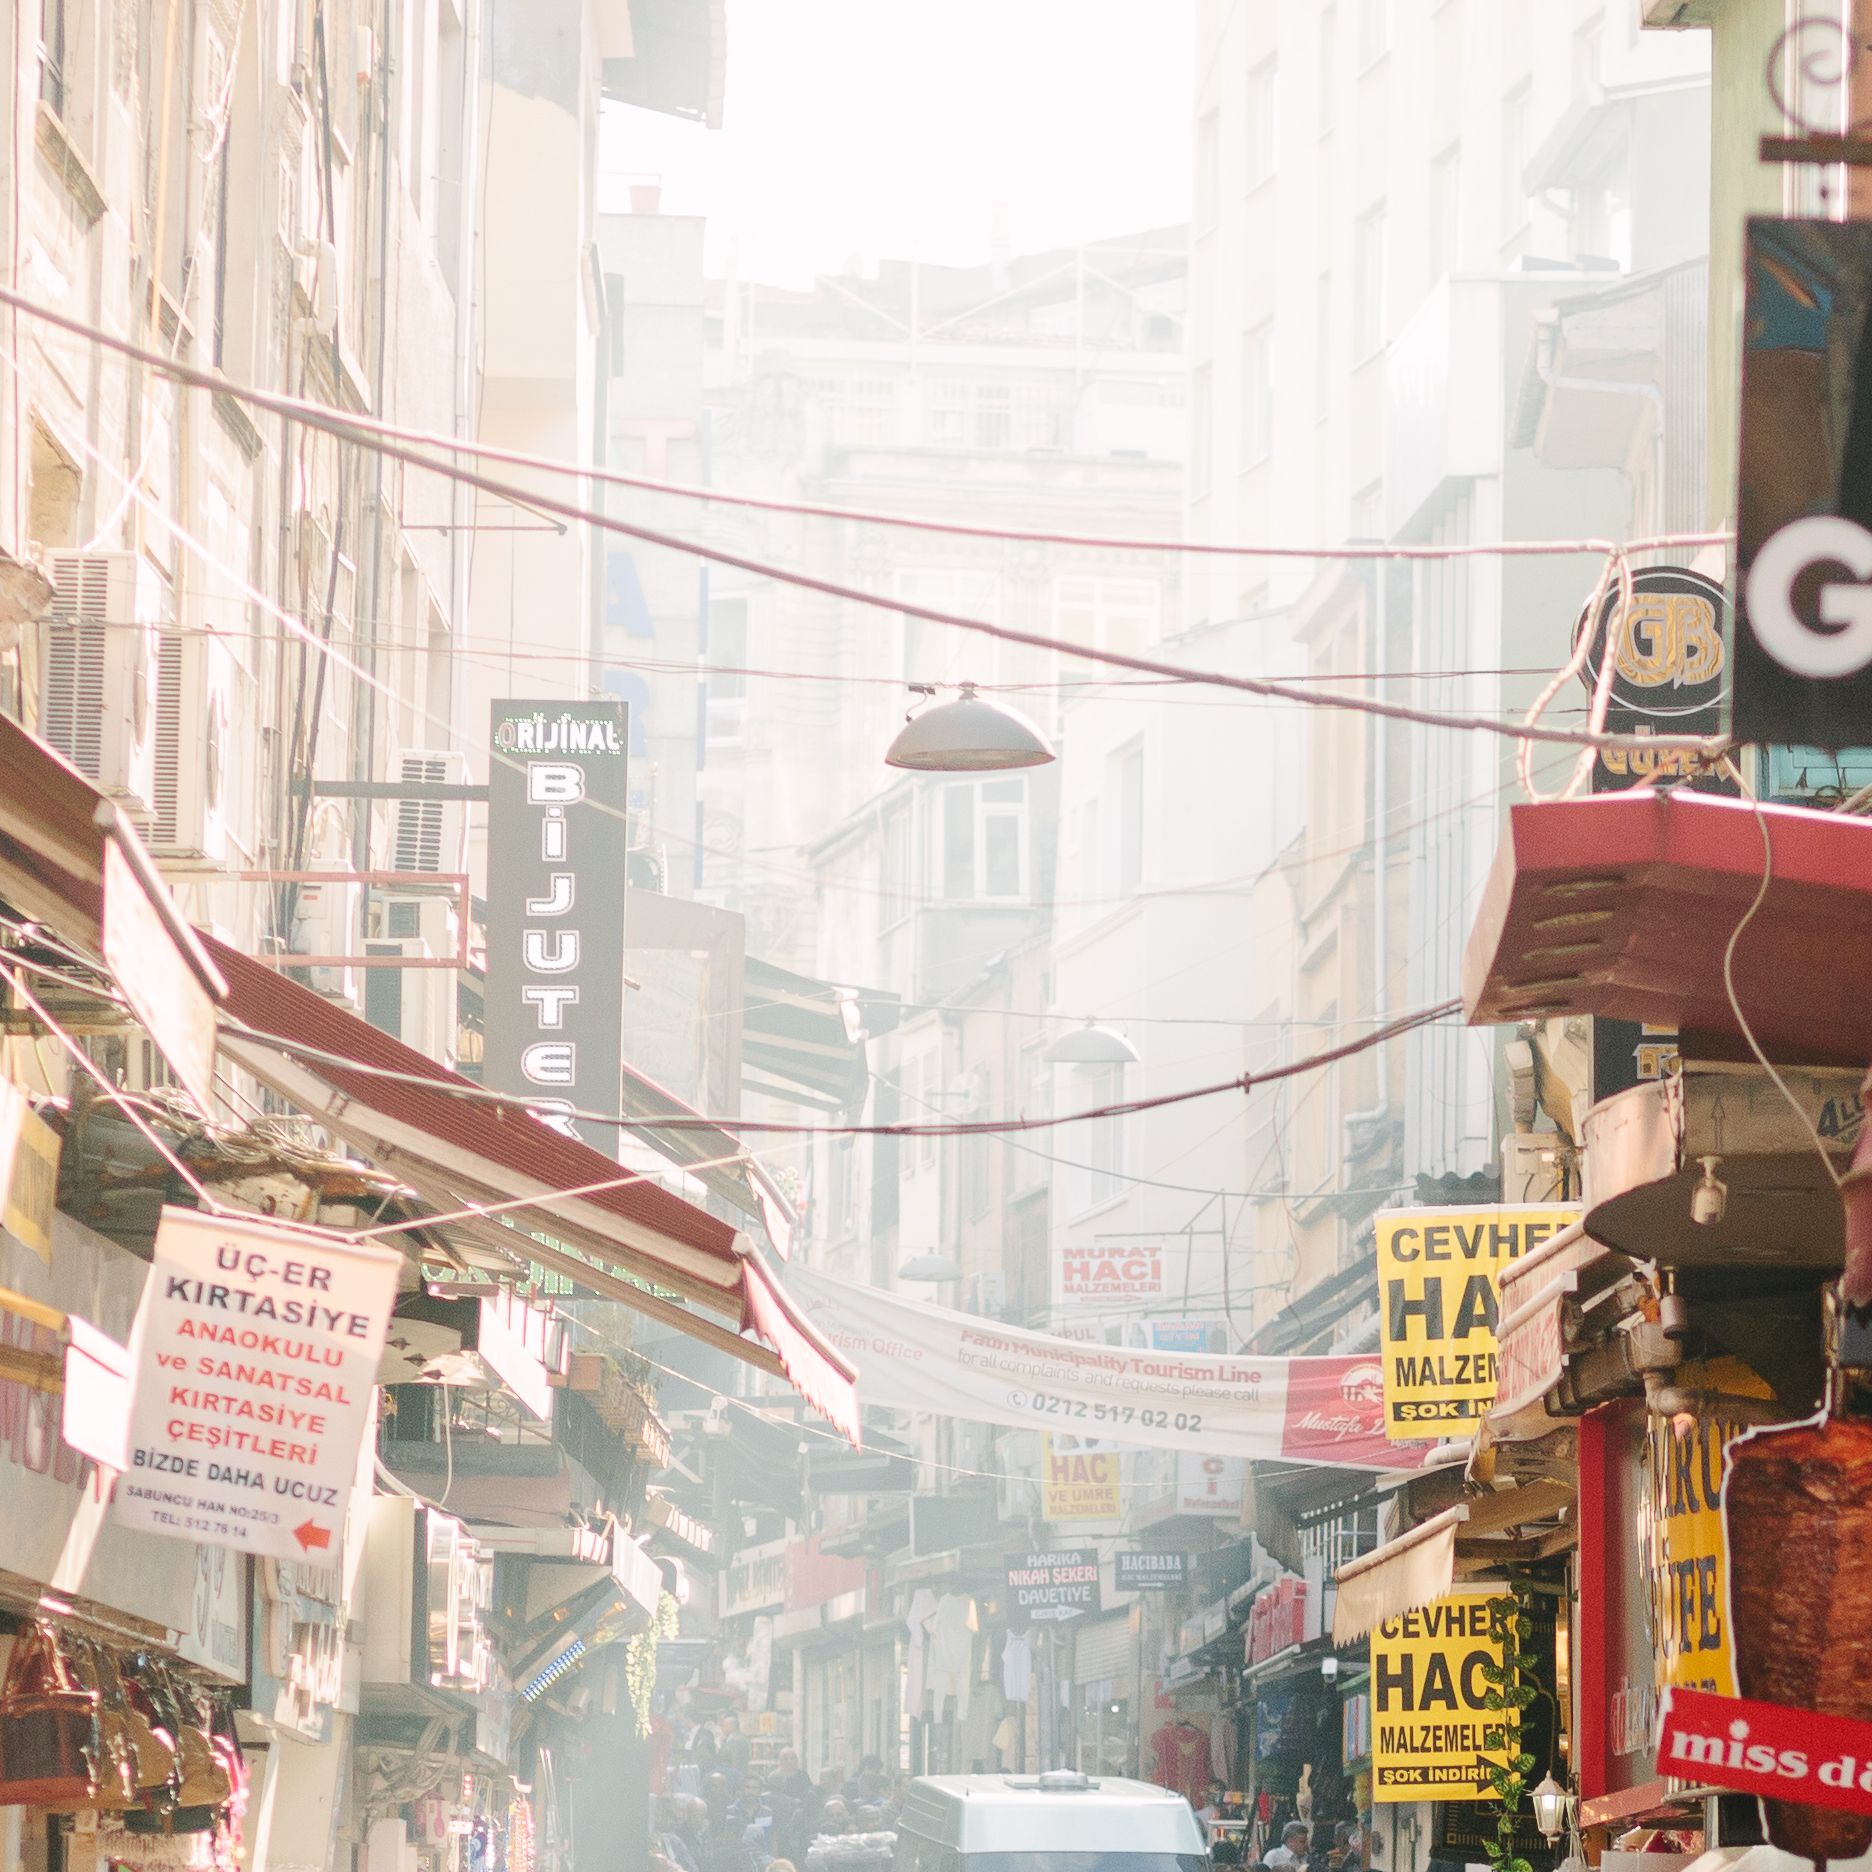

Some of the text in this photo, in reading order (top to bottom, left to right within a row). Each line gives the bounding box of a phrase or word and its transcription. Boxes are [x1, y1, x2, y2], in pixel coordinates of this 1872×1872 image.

[217, 1243, 332, 1291] ÜÇ-ER
[1063, 1259, 1161, 1281] HACI
[165, 1275, 370, 1339] KIRTASİYE
[1388, 1274, 1499, 1341] HA
[177, 1318, 344, 1368] ANAOKULU
[825, 1332, 924, 1361] rism Office
[155, 1352, 351, 1405] ve SANATSAL
[958, 1348, 1260, 1402] for all complaints and requests please call
[1130, 1358, 1215, 1382] Tourism
[1218, 1365, 1262, 1383] Line
[169, 1386, 326, 1435] KIRTASİYE
[1033, 1392, 1202, 1433] 0212 517 02 02
[1292, 1411, 1386, 1441] Mustafa D
[1400, 1399, 1495, 1421] ŞOK İN
[166, 1419, 319, 1466] ÇEŞİTLERİ
[133, 1447, 339, 1507] BİZDE DAHA UCUZ
[1050, 1453, 1108, 1485] HAC
[126, 1485, 192, 1508] SABUNCU
[197, 1497, 225, 1514] HAN
[1048, 1488, 1113, 1503] VE UMRE
[151, 1510, 181, 1527] TEL:
[185, 1516, 209, 1532] 512
[1121, 1554, 1182, 1571] HACIBABA
[1670, 1719, 1809, 1780] miss
[1383, 1768, 1422, 1786] ŞOK
